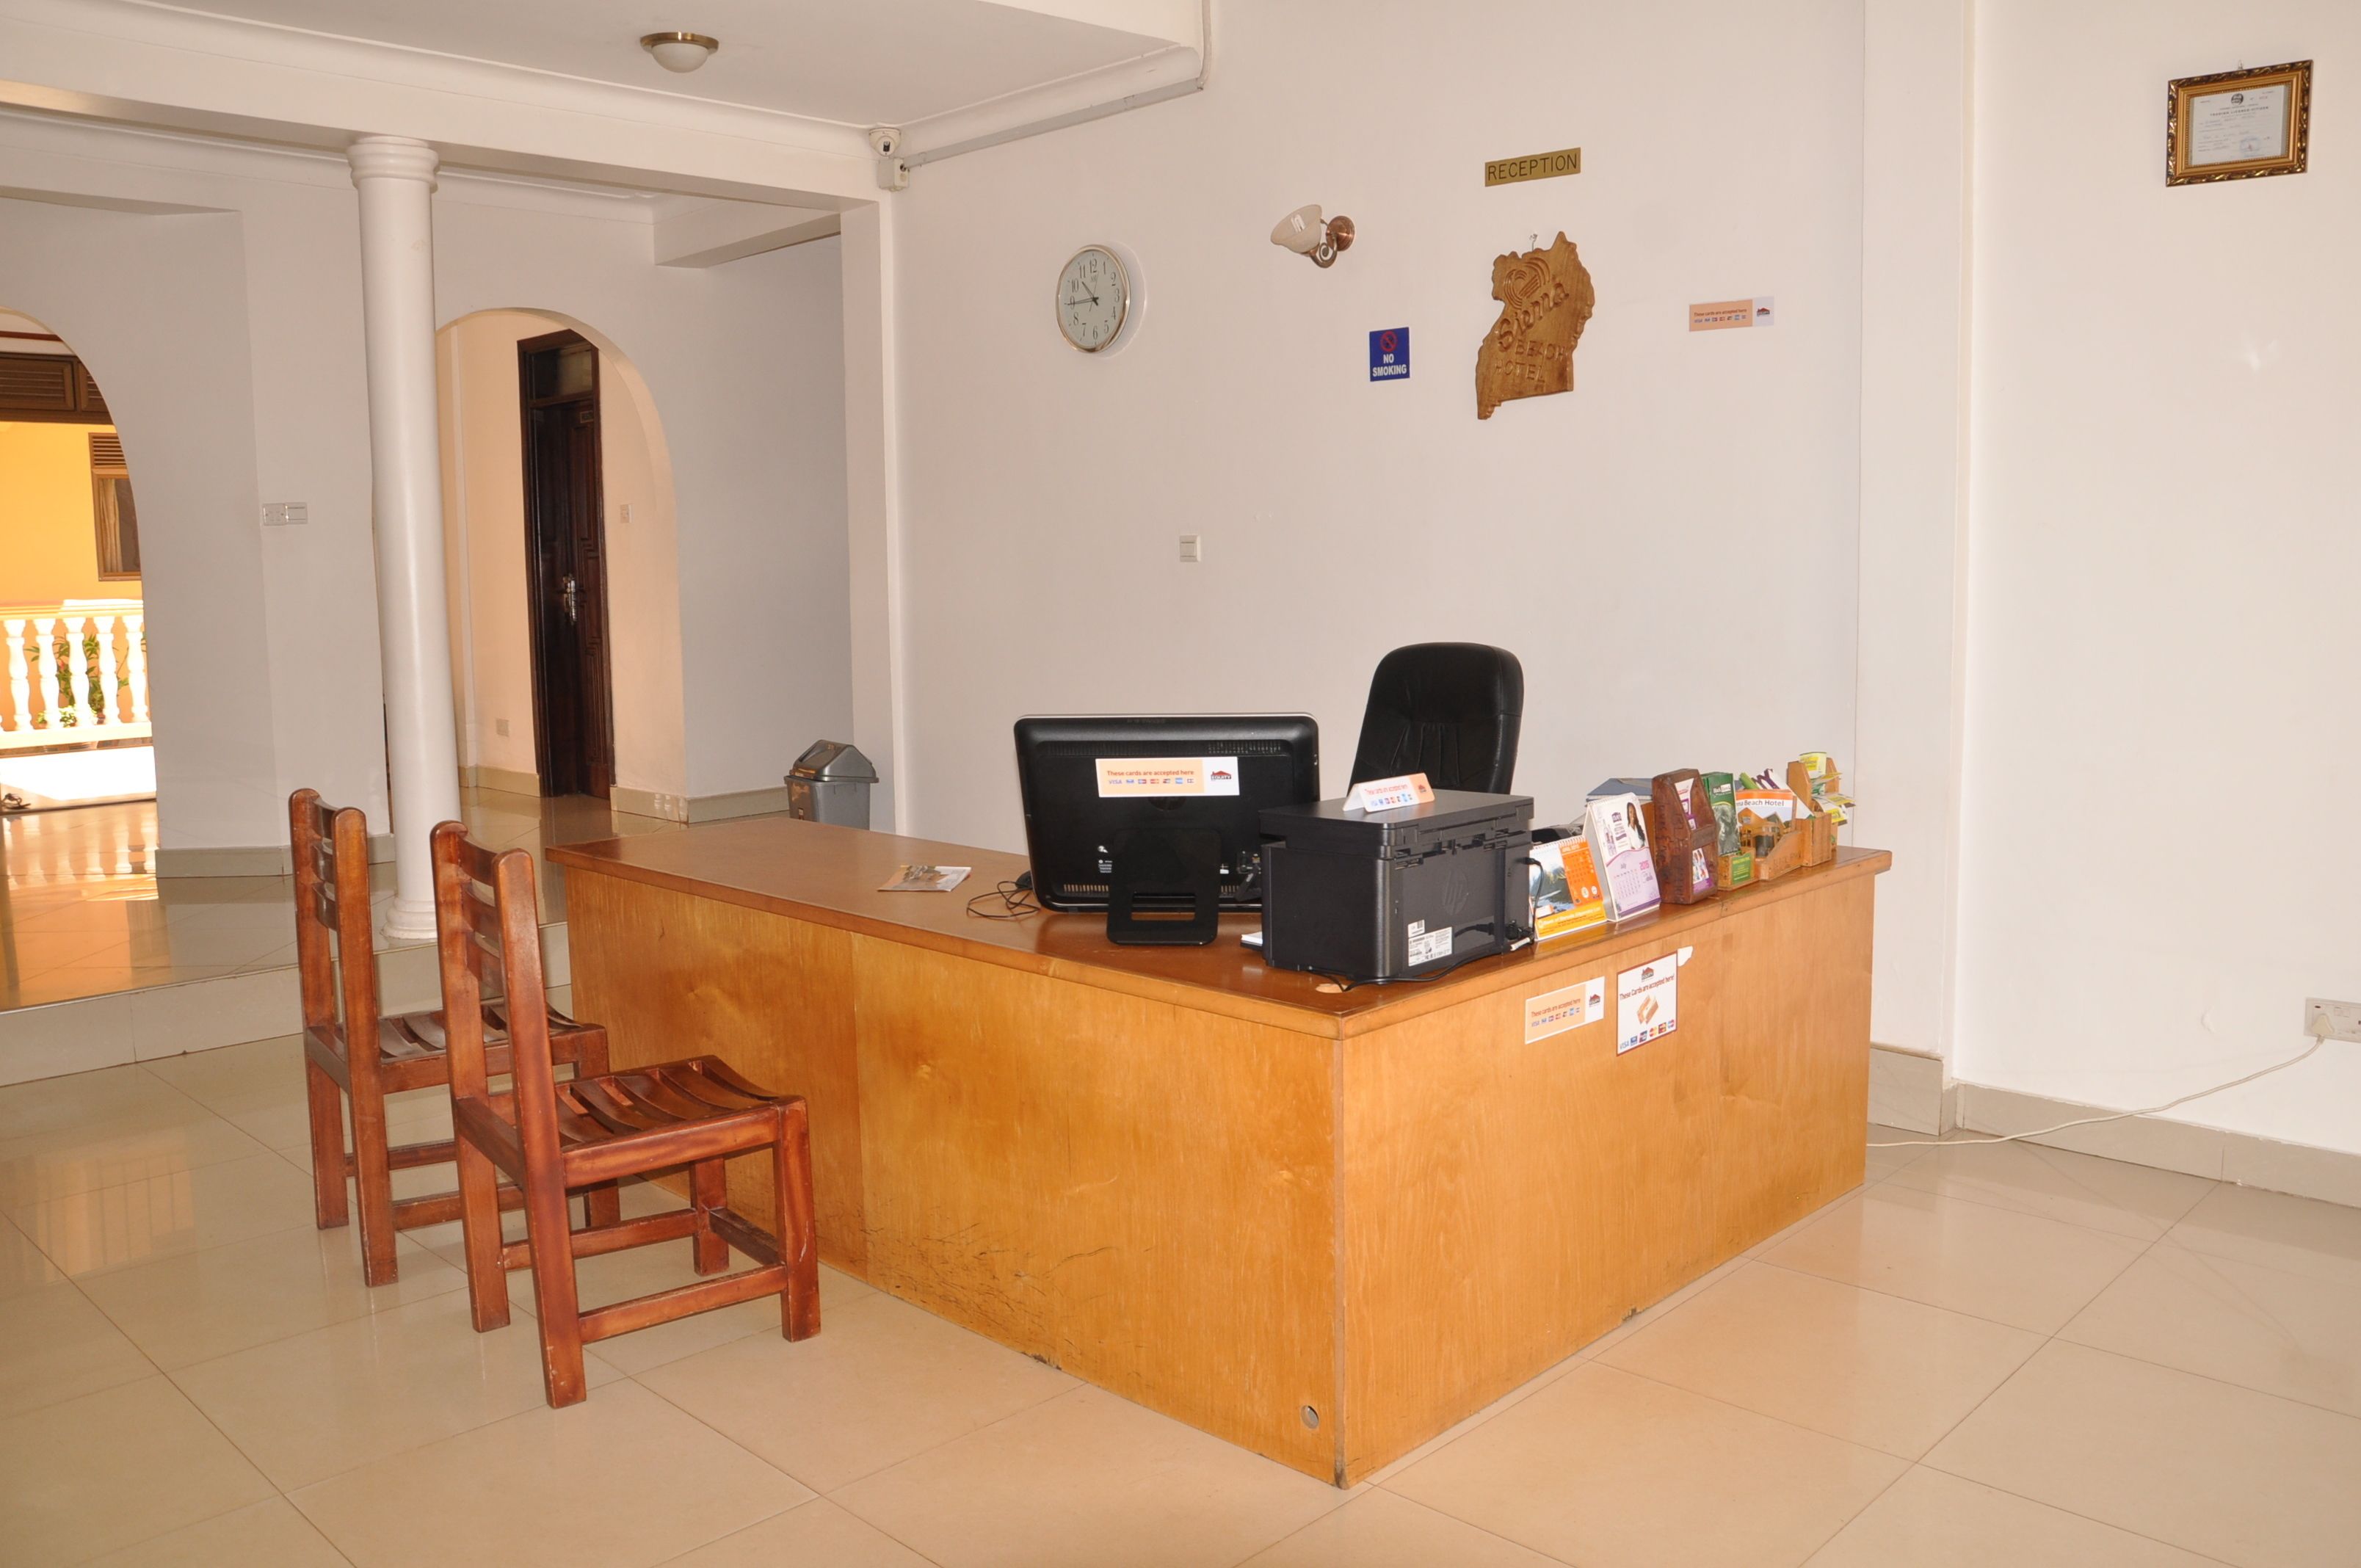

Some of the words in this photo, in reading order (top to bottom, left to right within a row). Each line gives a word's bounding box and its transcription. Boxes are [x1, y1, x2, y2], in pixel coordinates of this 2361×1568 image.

[1487, 153, 1577, 181] RECEPTION
[1079, 265, 1086, 278] 11
[1089, 258, 1097, 273] 12
[1072, 278, 1078, 294] 10
[1111, 272, 1116, 286] 2
[1115, 288, 1120, 302] 3
[1073, 312, 1078, 325] 8
[1111, 306, 1116, 319] 4
[1082, 323, 1087, 337] 7
[1093, 326, 1098, 339] 6
[1104, 320, 1109, 333] 5
[1383, 353, 1395, 363] NO
[1515, 340, 1565, 362] BEACH
[1372, 364, 1407, 377] SMOKING
[1495, 358, 1545, 383] HOTEL
